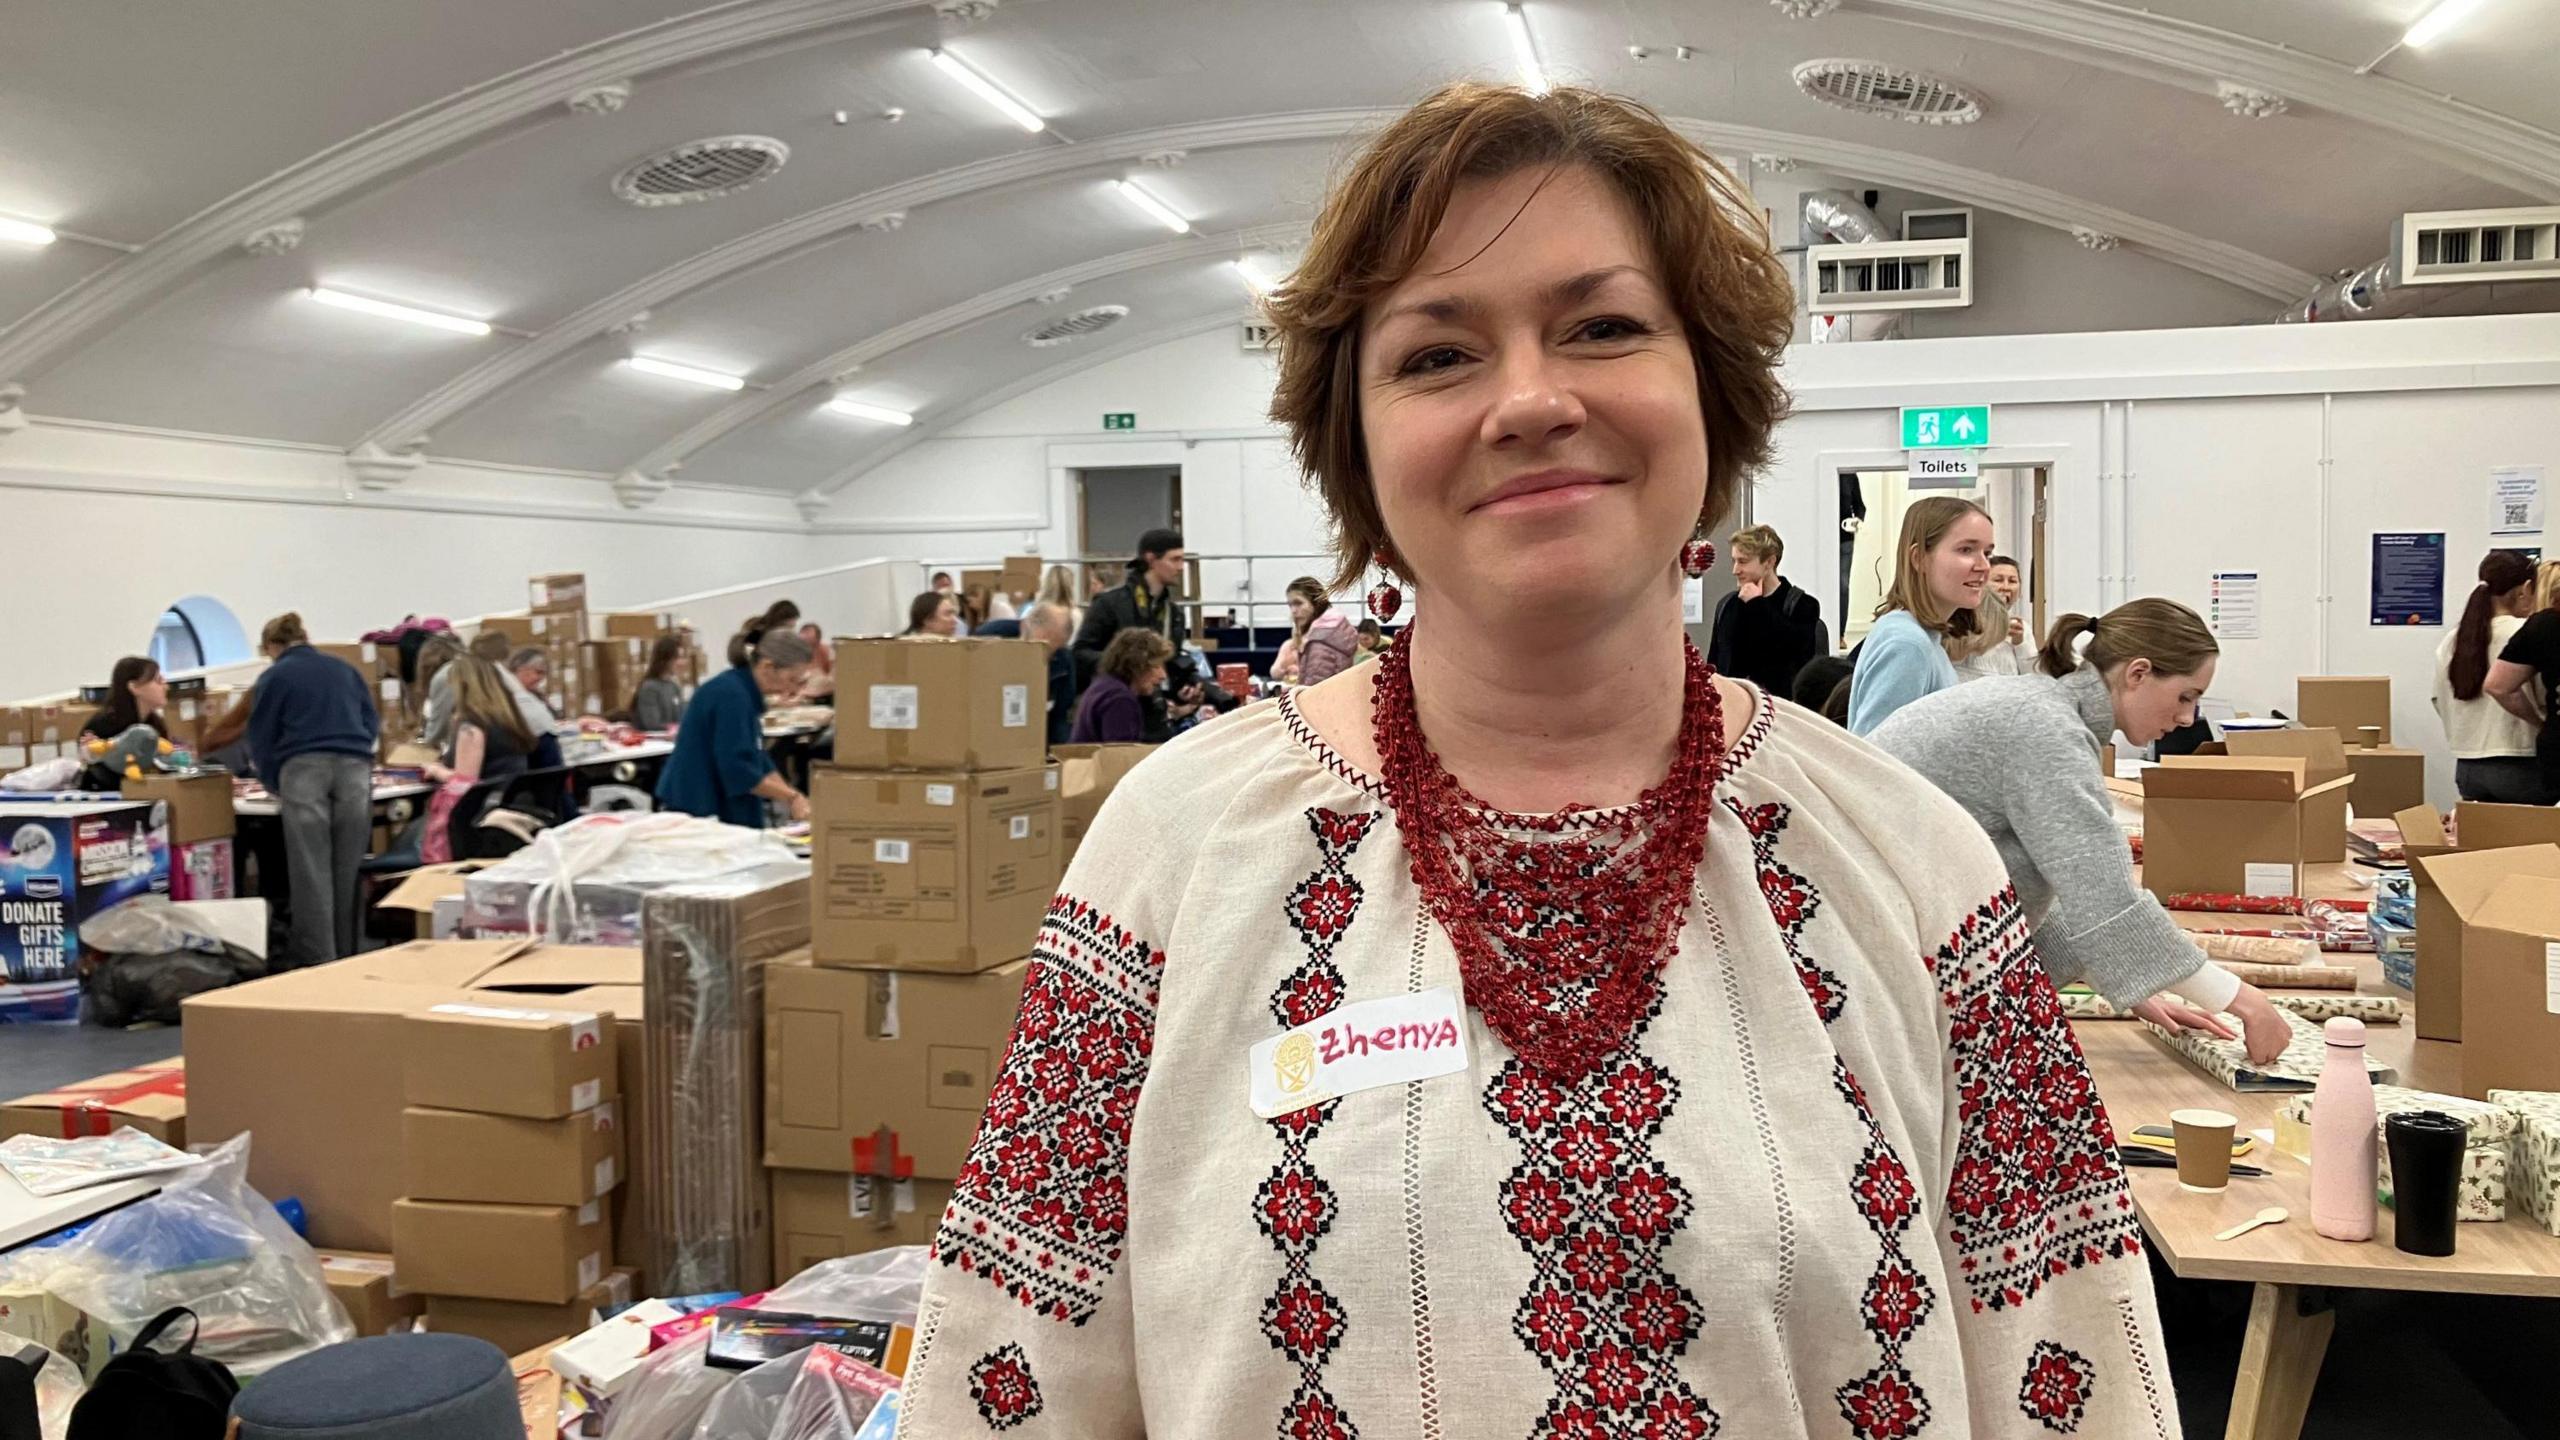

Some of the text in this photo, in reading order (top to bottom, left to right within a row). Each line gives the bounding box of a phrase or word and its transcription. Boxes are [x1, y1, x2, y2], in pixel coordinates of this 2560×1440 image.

[1919, 460, 1967, 473] Toilets
[3, 902, 63, 924] DONATE
[20, 925, 64, 946] GIFTS
[24, 947, 65, 968] HERE
